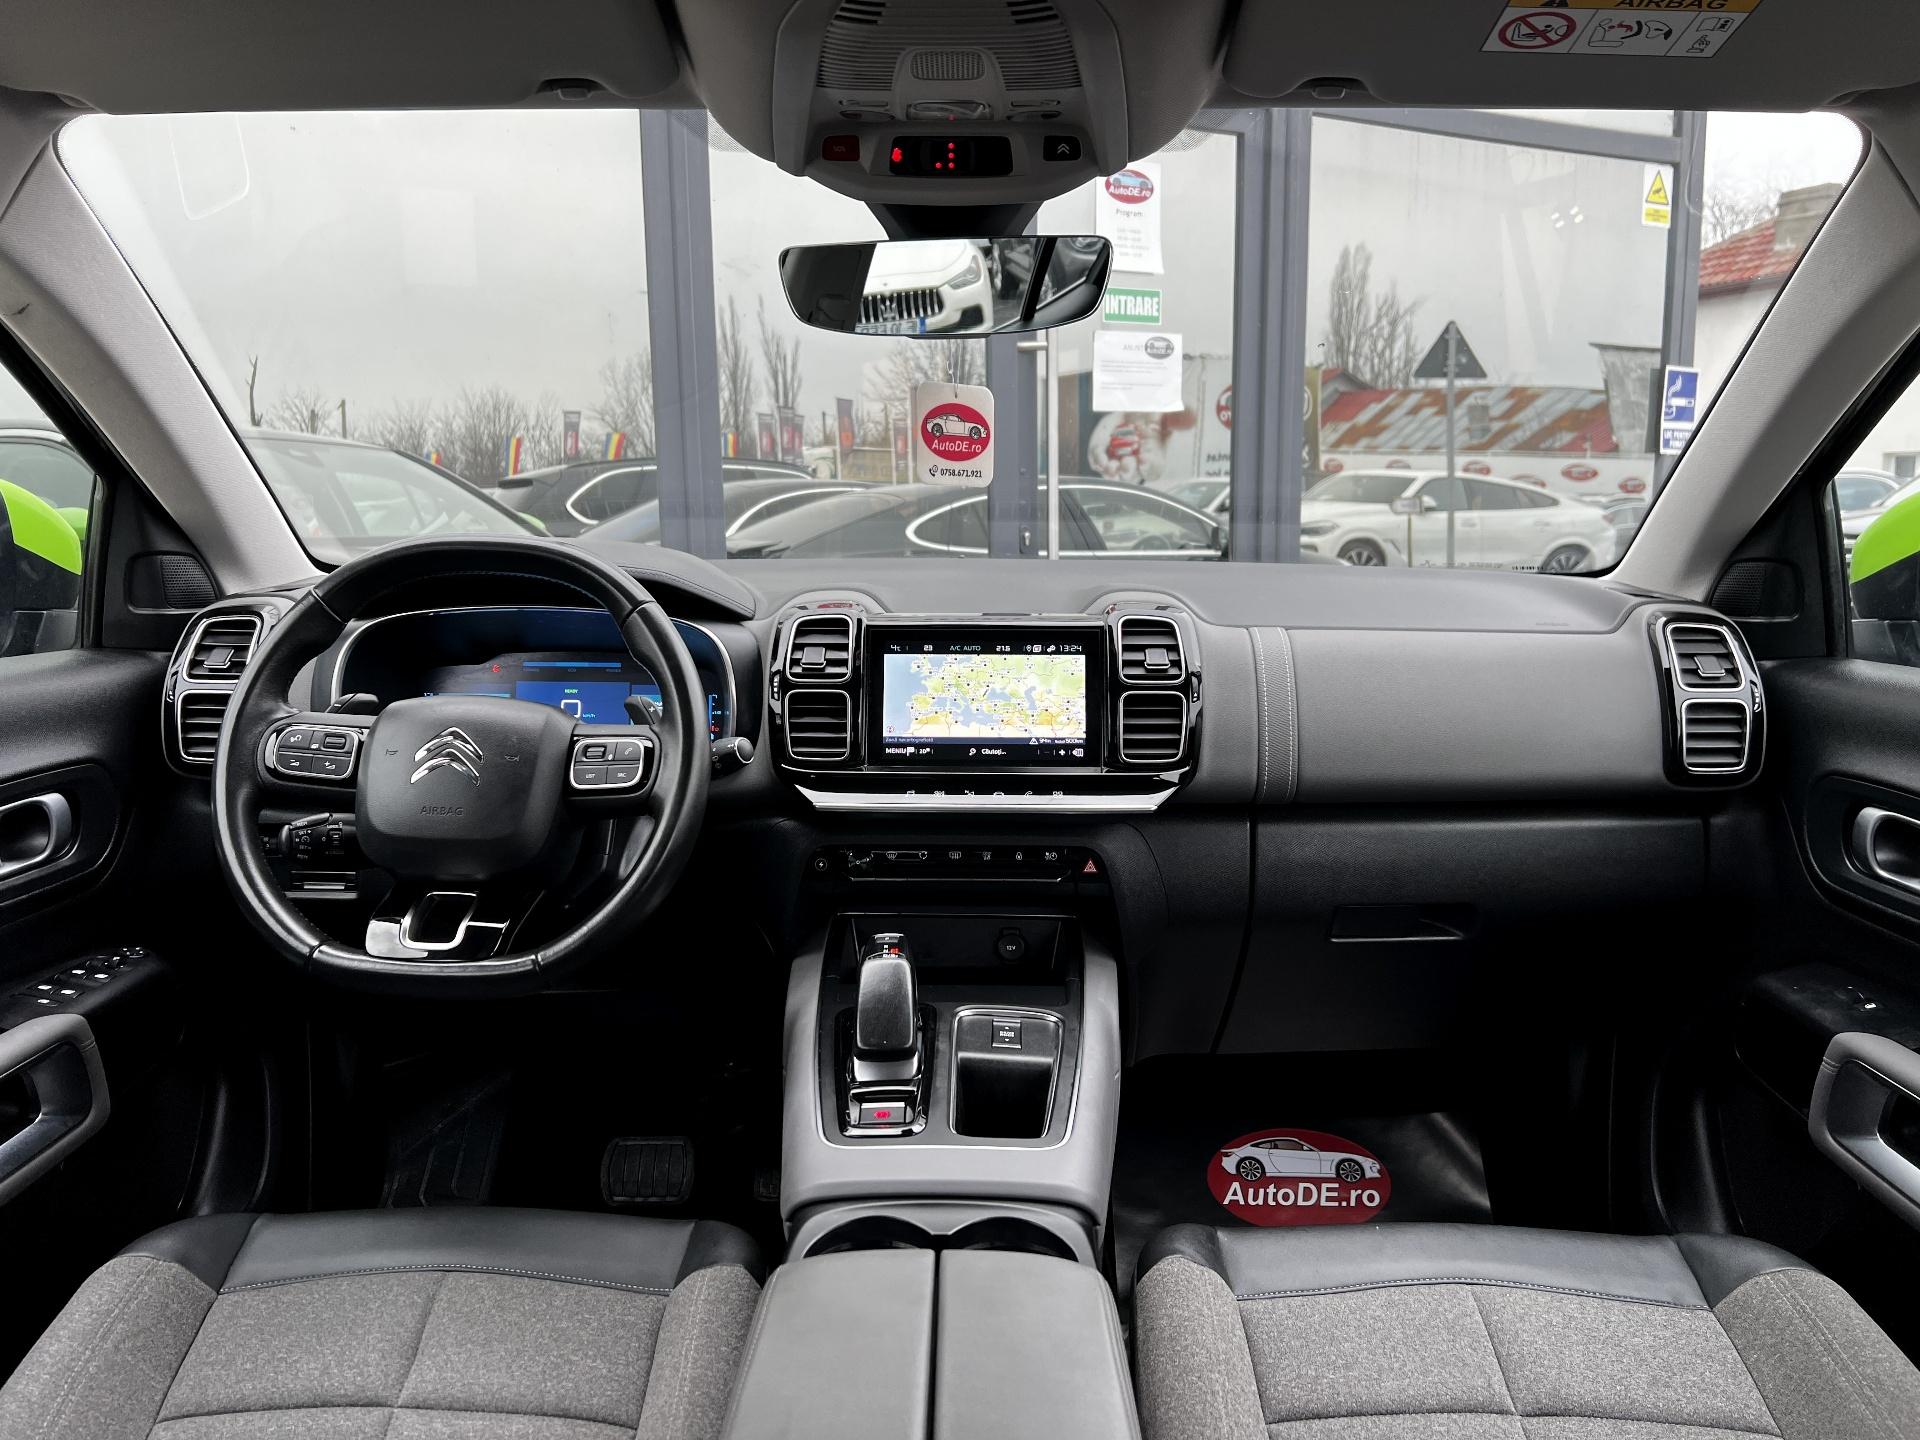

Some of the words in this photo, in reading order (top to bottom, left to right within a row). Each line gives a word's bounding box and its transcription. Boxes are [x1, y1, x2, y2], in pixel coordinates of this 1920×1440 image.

[1614, 0, 1726, 9] AIRBAG
[1109, 185, 1151, 198] AutoDE.ro
[1105, 294, 1160, 315] INTRARE
[931, 439, 982, 453] AutoDE.ro
[940, 468, 982, 478] 0758.671.921
[1059, 644, 1082, 652] 13:24
[420, 806, 464, 817] AIRBAG
[1223, 1181, 1381, 1207] AutoDE.ro
